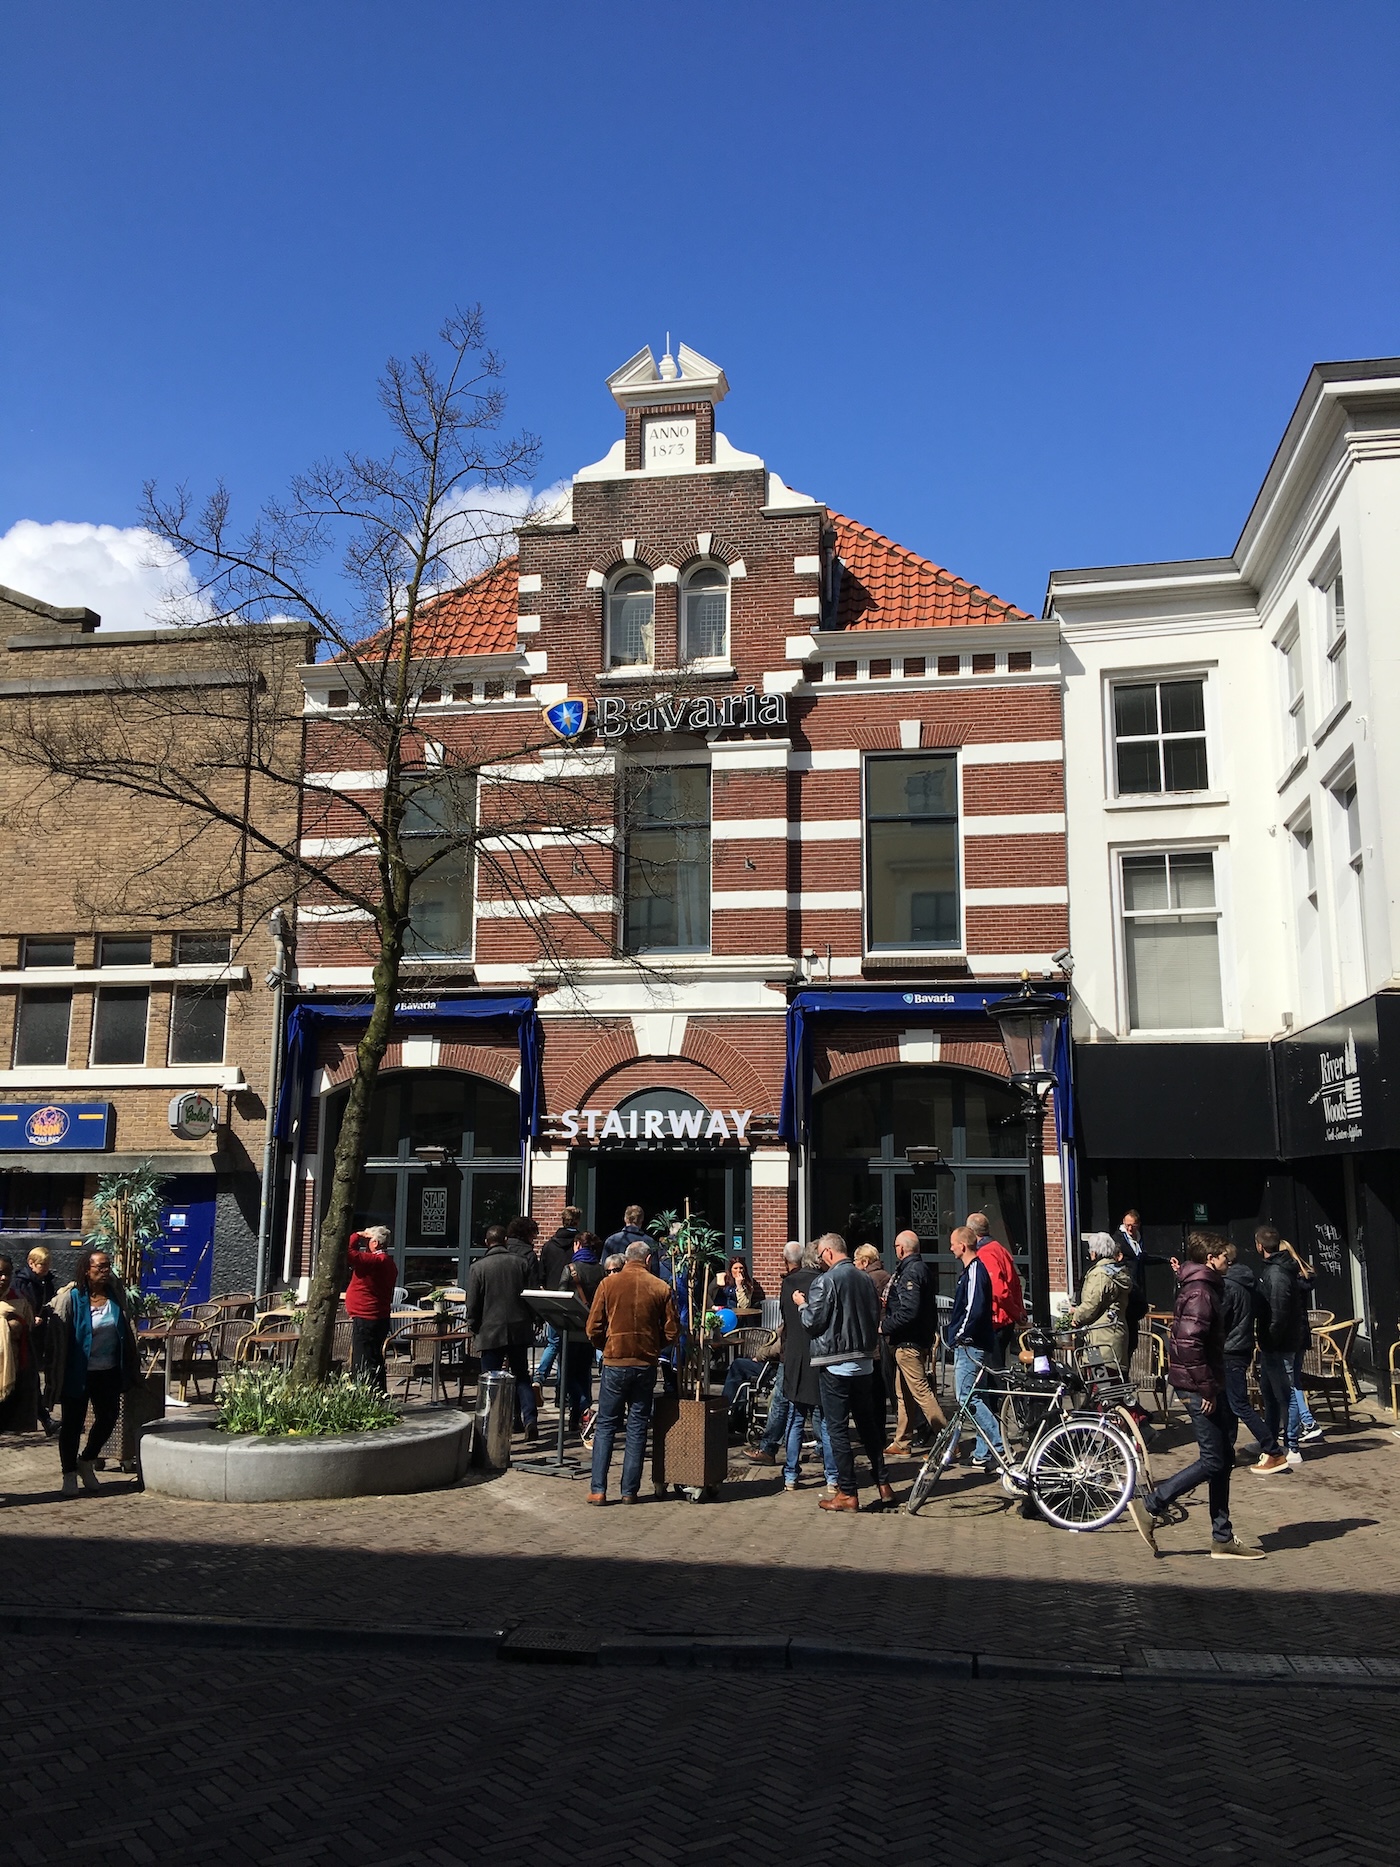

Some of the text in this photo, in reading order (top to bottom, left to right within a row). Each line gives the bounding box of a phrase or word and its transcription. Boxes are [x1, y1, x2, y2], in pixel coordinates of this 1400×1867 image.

[650, 426, 689, 440] ANNO
[652, 443, 685, 457] 1873
[596, 685, 788, 737] Bavaria
[400, 1001, 437, 1011] Bavaria
[914, 993, 955, 1004] Bavaria
[1320, 1052, 1344, 1084] River
[185, 1105, 211, 1124] Grolsch
[1323, 1093, 1347, 1123] Woods
[34, 1123, 60, 1136] BISON
[561, 1109, 753, 1139] STAIRWAY
[29, 1135, 61, 1144] BOWLING
[424, 1192, 445, 1208] STAIR
[913, 1193, 937, 1211] STAIR
[423, 1221, 445, 1231] HEAVEN
